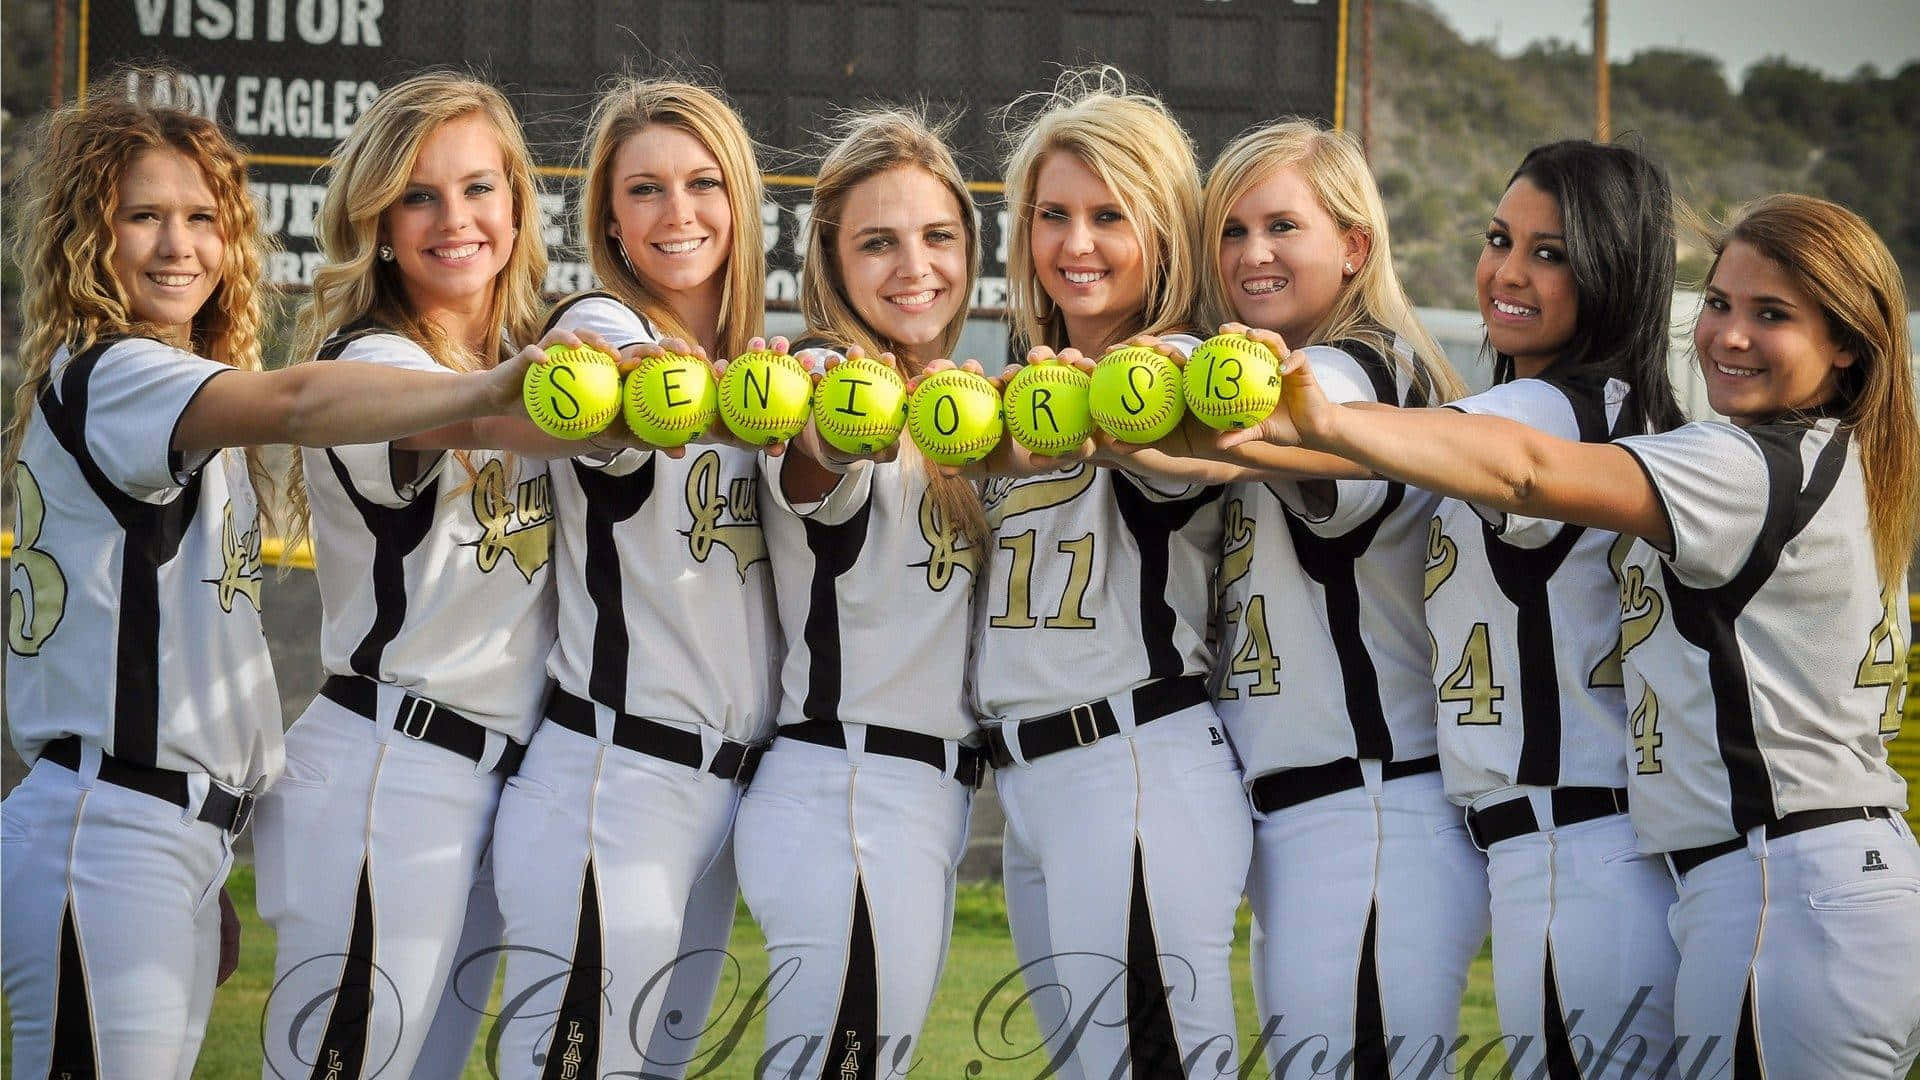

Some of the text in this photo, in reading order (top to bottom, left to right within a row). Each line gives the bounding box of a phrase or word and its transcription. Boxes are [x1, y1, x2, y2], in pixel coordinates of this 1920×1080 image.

[134, 0, 385, 47] VISITOR
[236, 75, 381, 139] EAGLES
[989, 528, 1096, 630] 11
